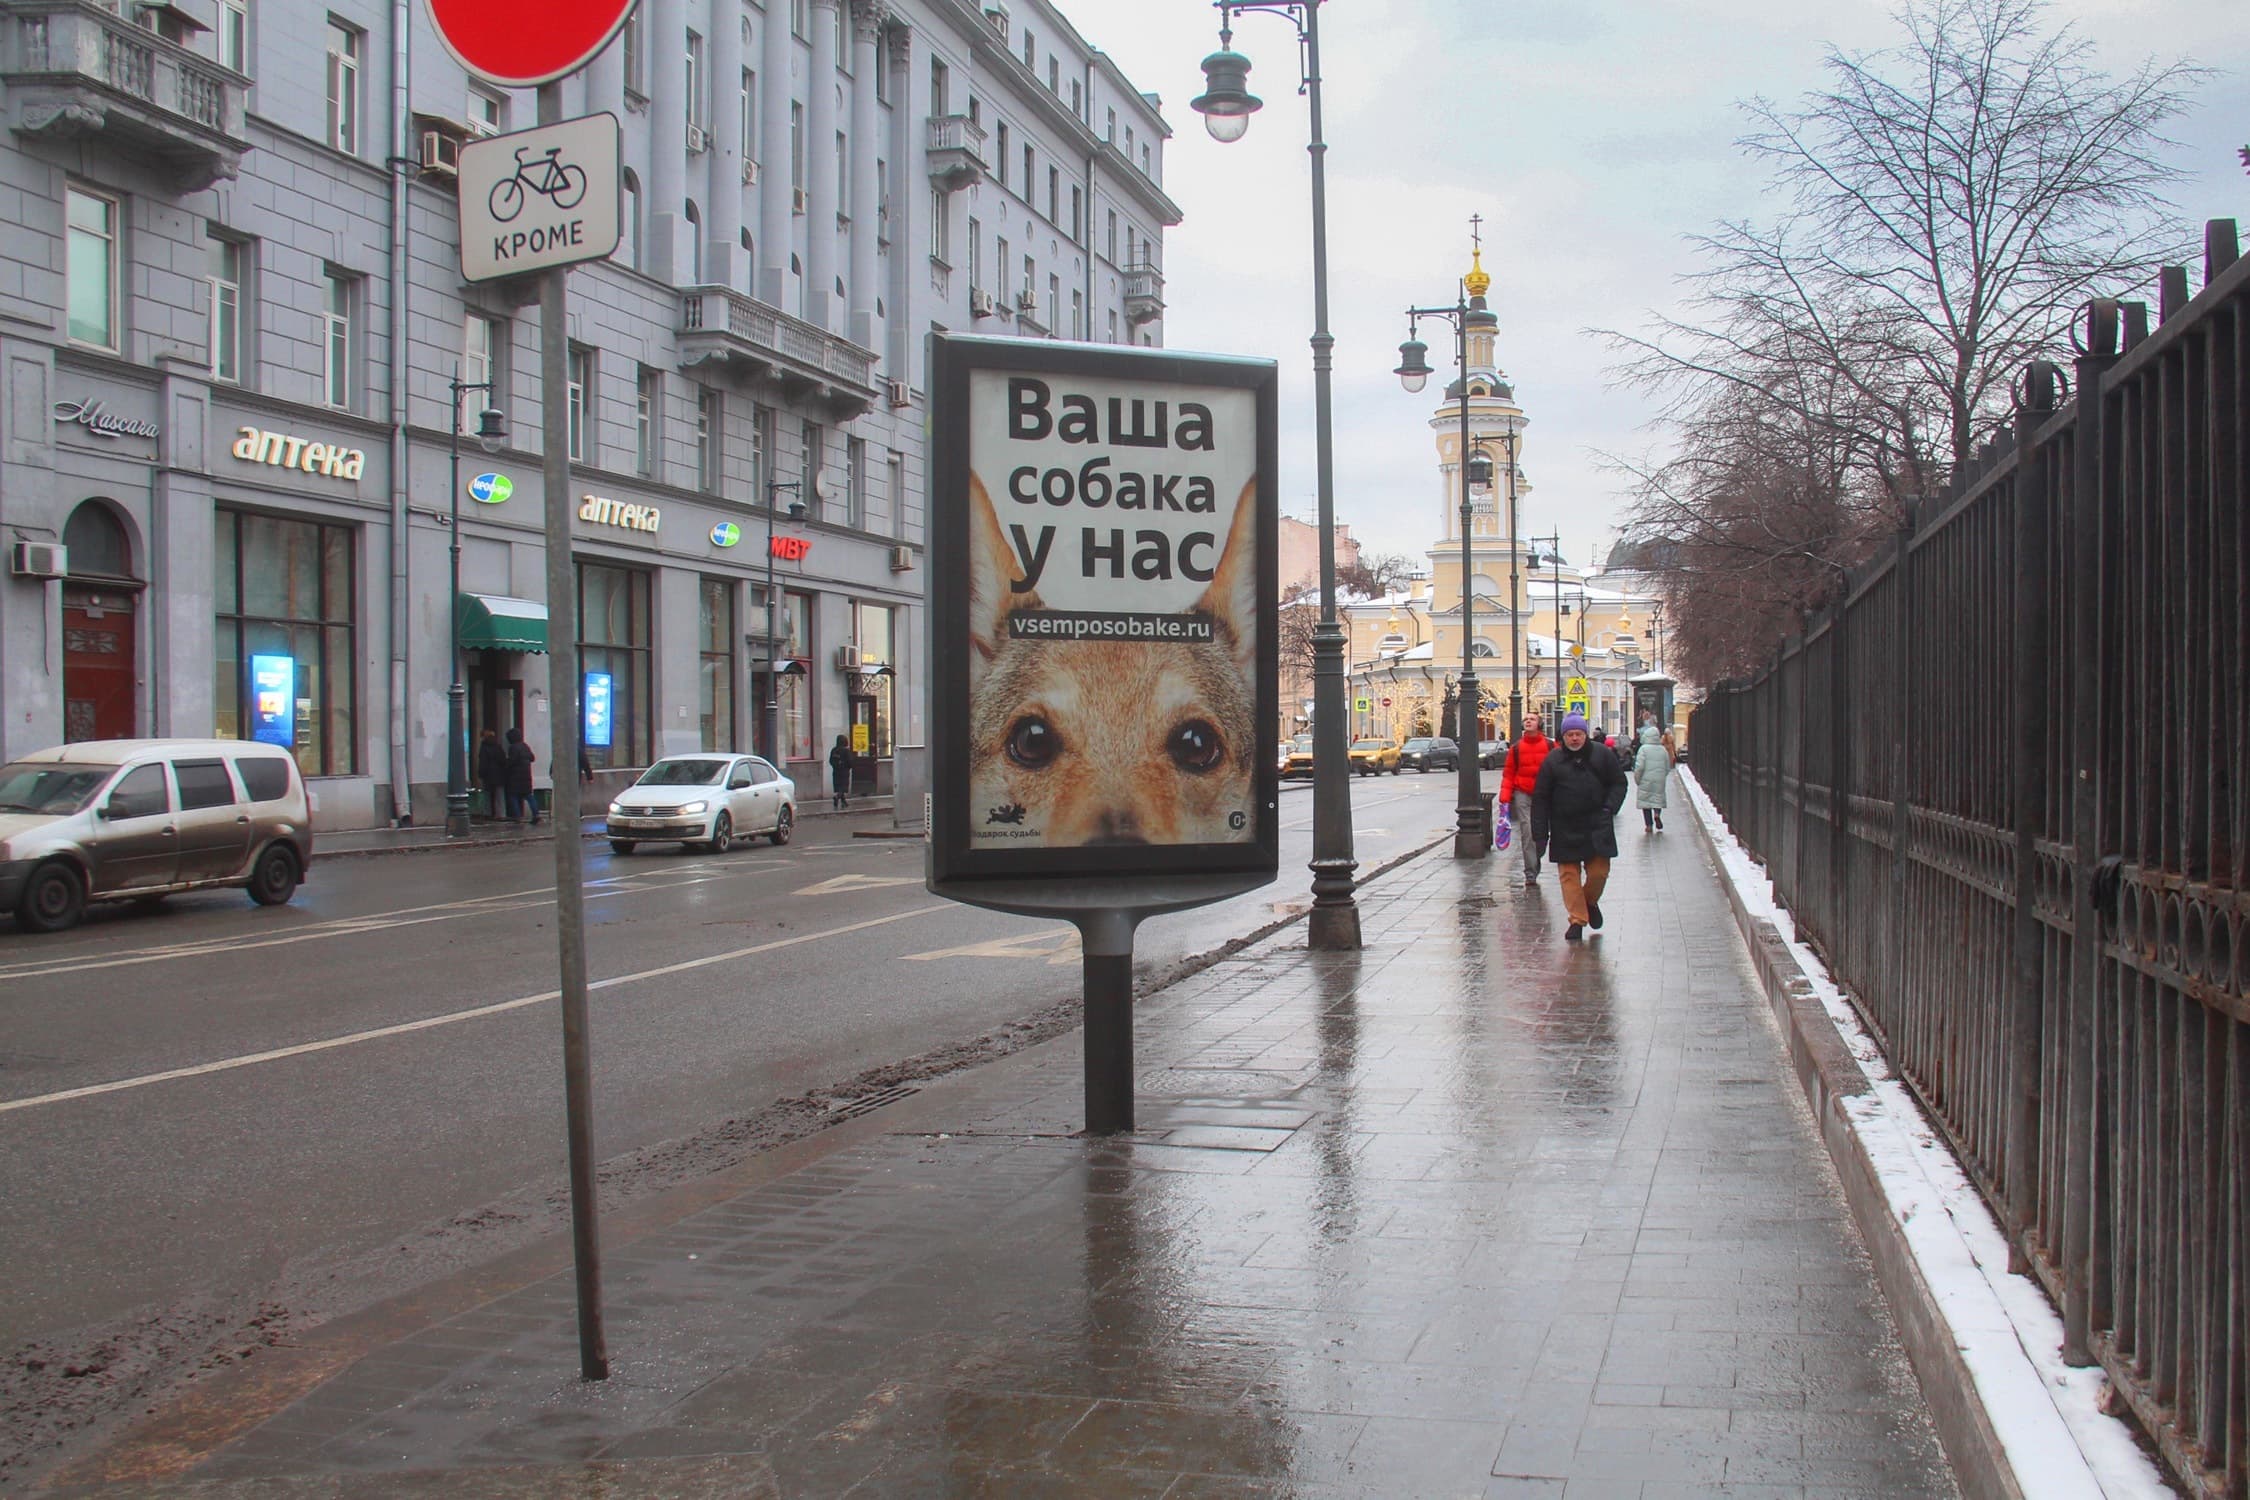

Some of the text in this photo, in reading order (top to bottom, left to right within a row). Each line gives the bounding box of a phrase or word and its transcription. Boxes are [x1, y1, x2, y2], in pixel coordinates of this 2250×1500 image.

[494, 219, 584, 261] КРОМЕ
[54, 397, 160, 438] Mascara
[1008, 376, 1216, 451] Ваша
[232, 425, 366, 481] аптека
[1008, 456, 1216, 513] собака
[578, 494, 661, 533] аптека
[1008, 523, 1216, 594] у нас
[1014, 616, 1210, 639] vsemposobake.ru
[1009, 829, 1041, 839] судьбы
